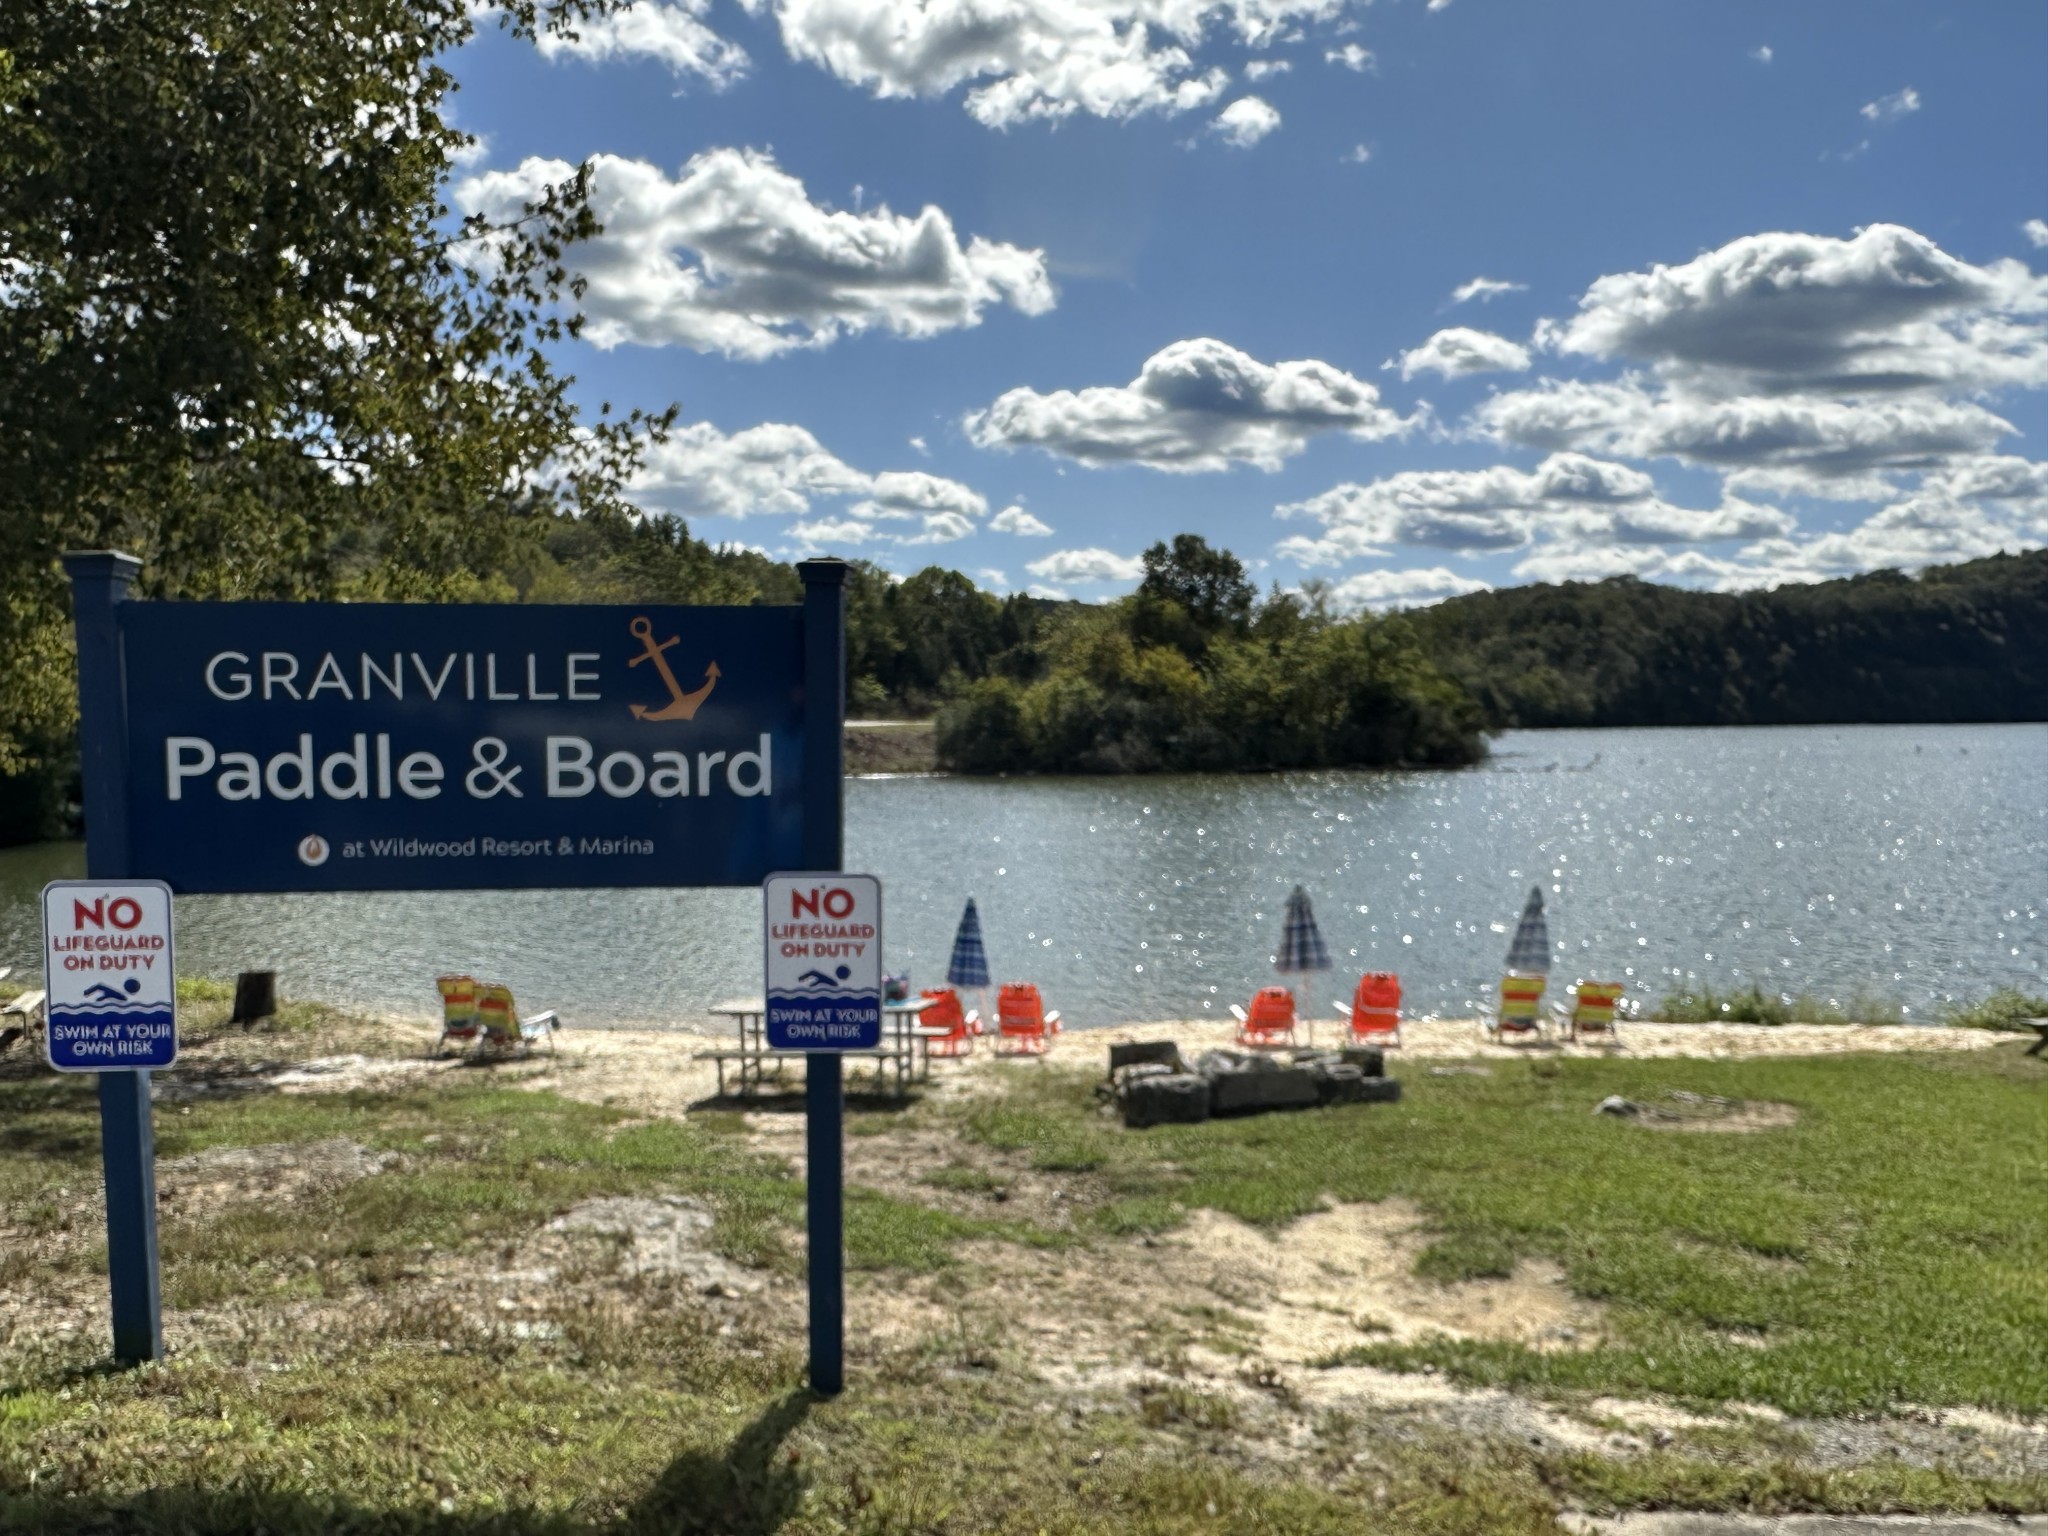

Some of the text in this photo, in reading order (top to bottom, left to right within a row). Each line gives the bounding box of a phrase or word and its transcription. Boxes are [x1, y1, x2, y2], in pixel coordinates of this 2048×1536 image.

[205, 651, 601, 701] GRANVILLE
[166, 733, 772, 800] Paddle & Board
[342, 835, 655, 858] at Wildwood Resort & Marina
[790, 888, 855, 920] NO
[74, 896, 143, 931] NO
[771, 923, 875, 940] LIFEGUARD
[53, 935, 165, 952] LIFEGUARD
[780, 941, 866, 958] ON DUTY
[63, 954, 155, 971] ON DUTY
[770, 1008, 878, 1024] SWIM AT YOUR
[53, 1023, 171, 1040] SWIM AT YOUR
[786, 1023, 861, 1039] OWN RISK
[72, 1040, 153, 1057] OWN RISK
